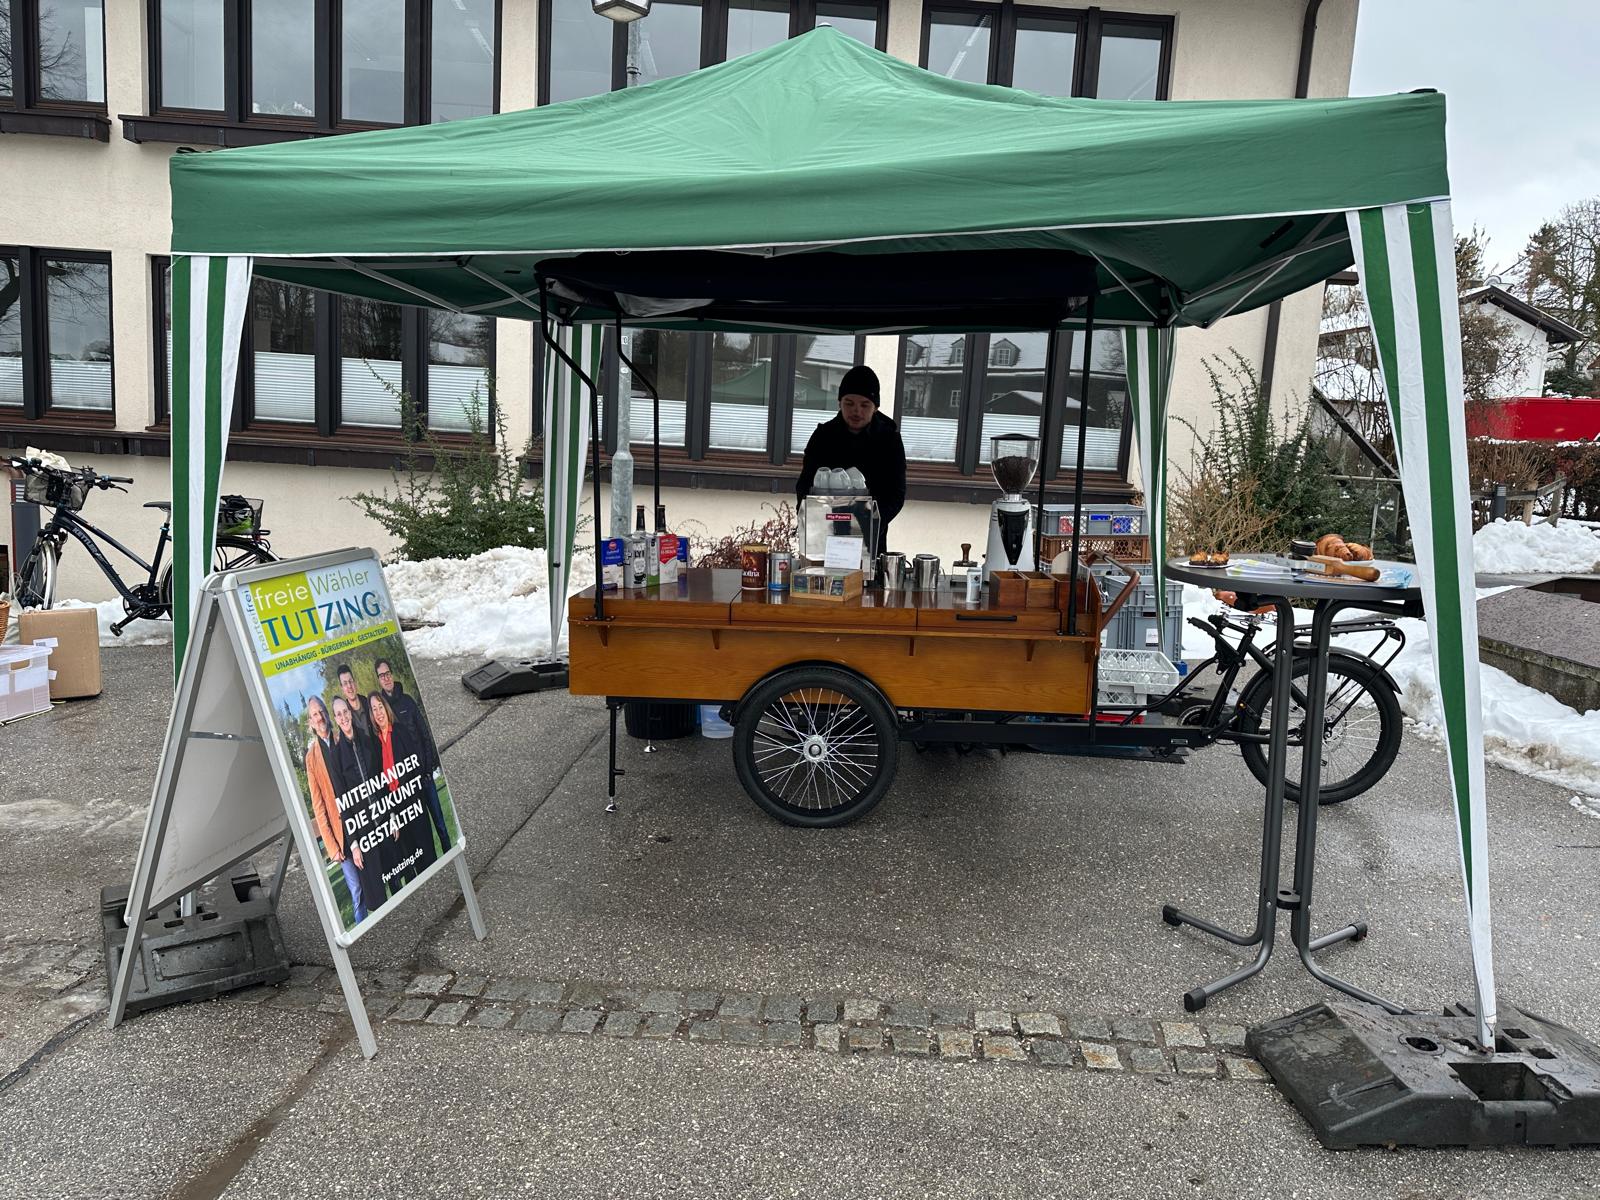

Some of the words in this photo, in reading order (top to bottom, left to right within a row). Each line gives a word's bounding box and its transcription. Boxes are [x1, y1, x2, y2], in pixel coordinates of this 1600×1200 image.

[255, 583, 309, 611] freie
[309, 568, 369, 595] Wähler
[261, 591, 381, 646] TUTZING
[275, 650, 318, 670] UNABHÄNGIG
[320, 638, 354, 654] BÜRGERNAH
[358, 627, 388, 641] GESTALTEND
[335, 753, 420, 813] MITEINANDER
[344, 810, 369, 835] DIE
[369, 775, 423, 820] ZUKUNFT
[359, 800, 424, 853] GESTALTEN
[381, 847, 423, 883] fw-tutzing.de
